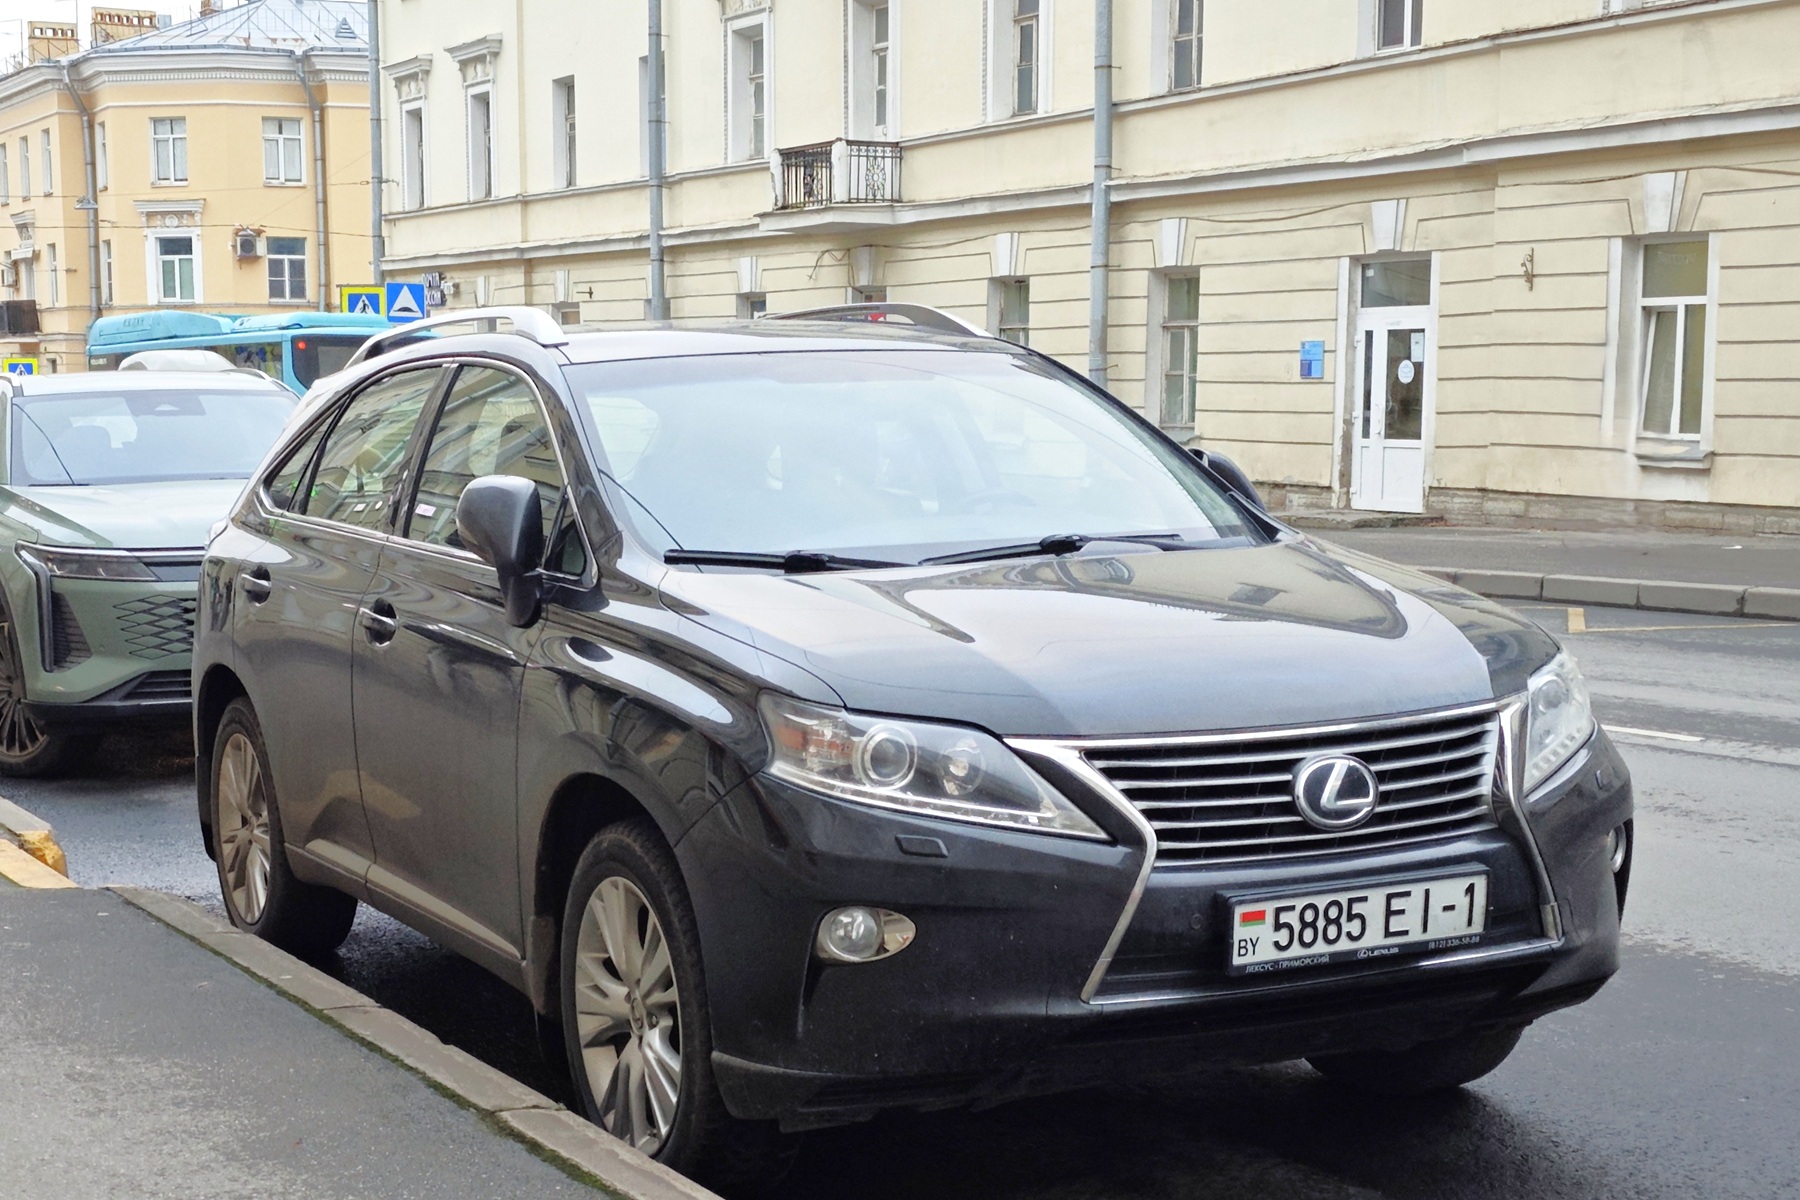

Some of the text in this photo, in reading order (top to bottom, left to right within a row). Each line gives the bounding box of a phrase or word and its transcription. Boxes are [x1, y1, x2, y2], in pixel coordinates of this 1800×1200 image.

[1273, 896, 1368, 951] 5885
[1237, 937, 1260, 957] BY
[1368, 947, 1399, 957] LEXUS
[1428, 939, 1446, 950] (812)
[1245, 963, 1274, 974] ЛЕКСУС
[1279, 954, 1330, 969] ПРИМОРСКИЙ
